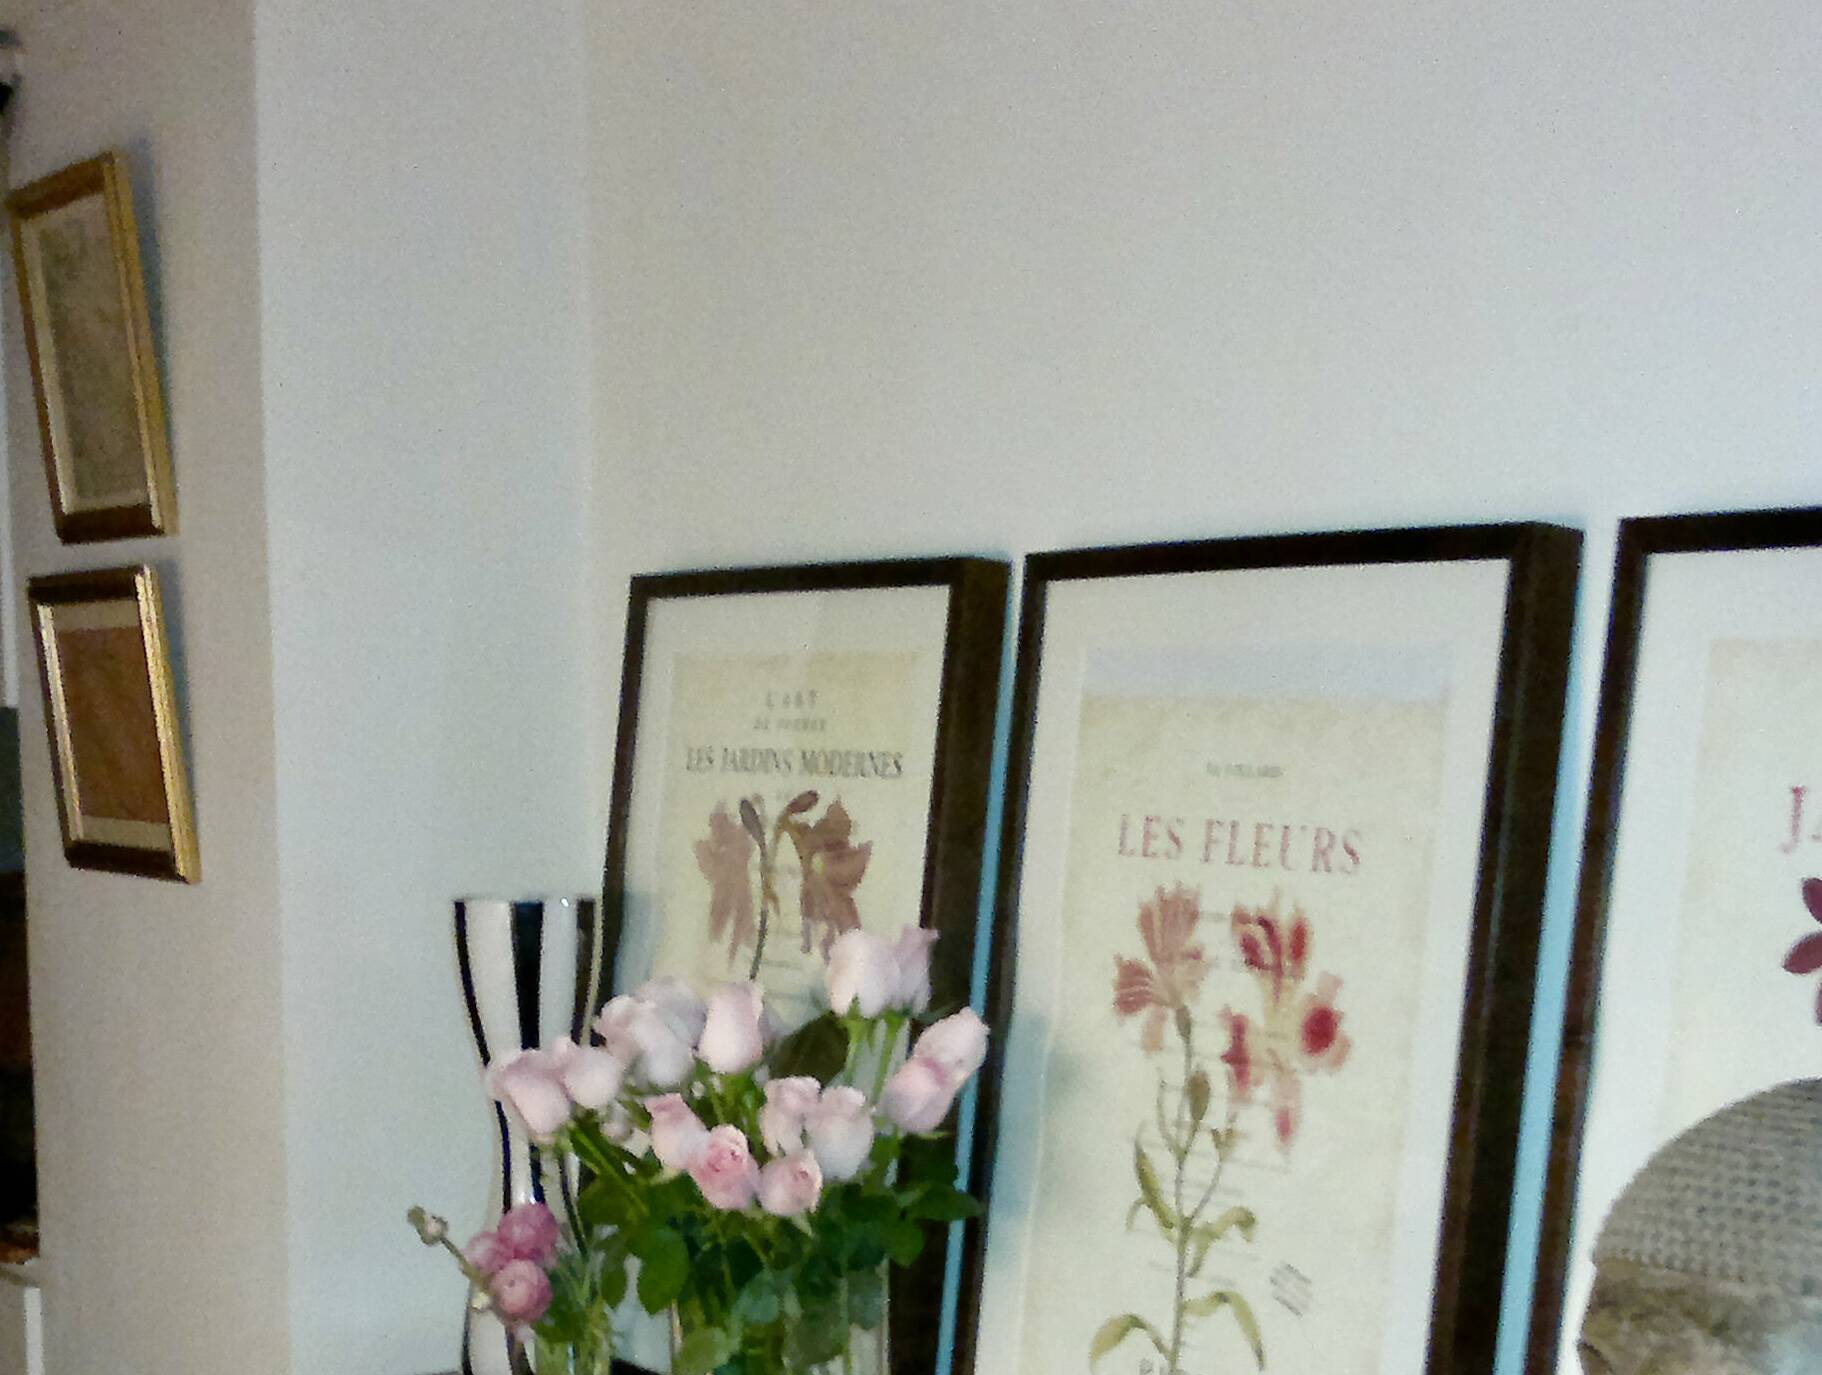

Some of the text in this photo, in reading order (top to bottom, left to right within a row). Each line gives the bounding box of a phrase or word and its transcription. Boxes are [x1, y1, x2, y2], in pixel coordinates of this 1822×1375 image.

[686, 745, 714, 772] LES
[1118, 814, 1363, 875] LES FLEURS
